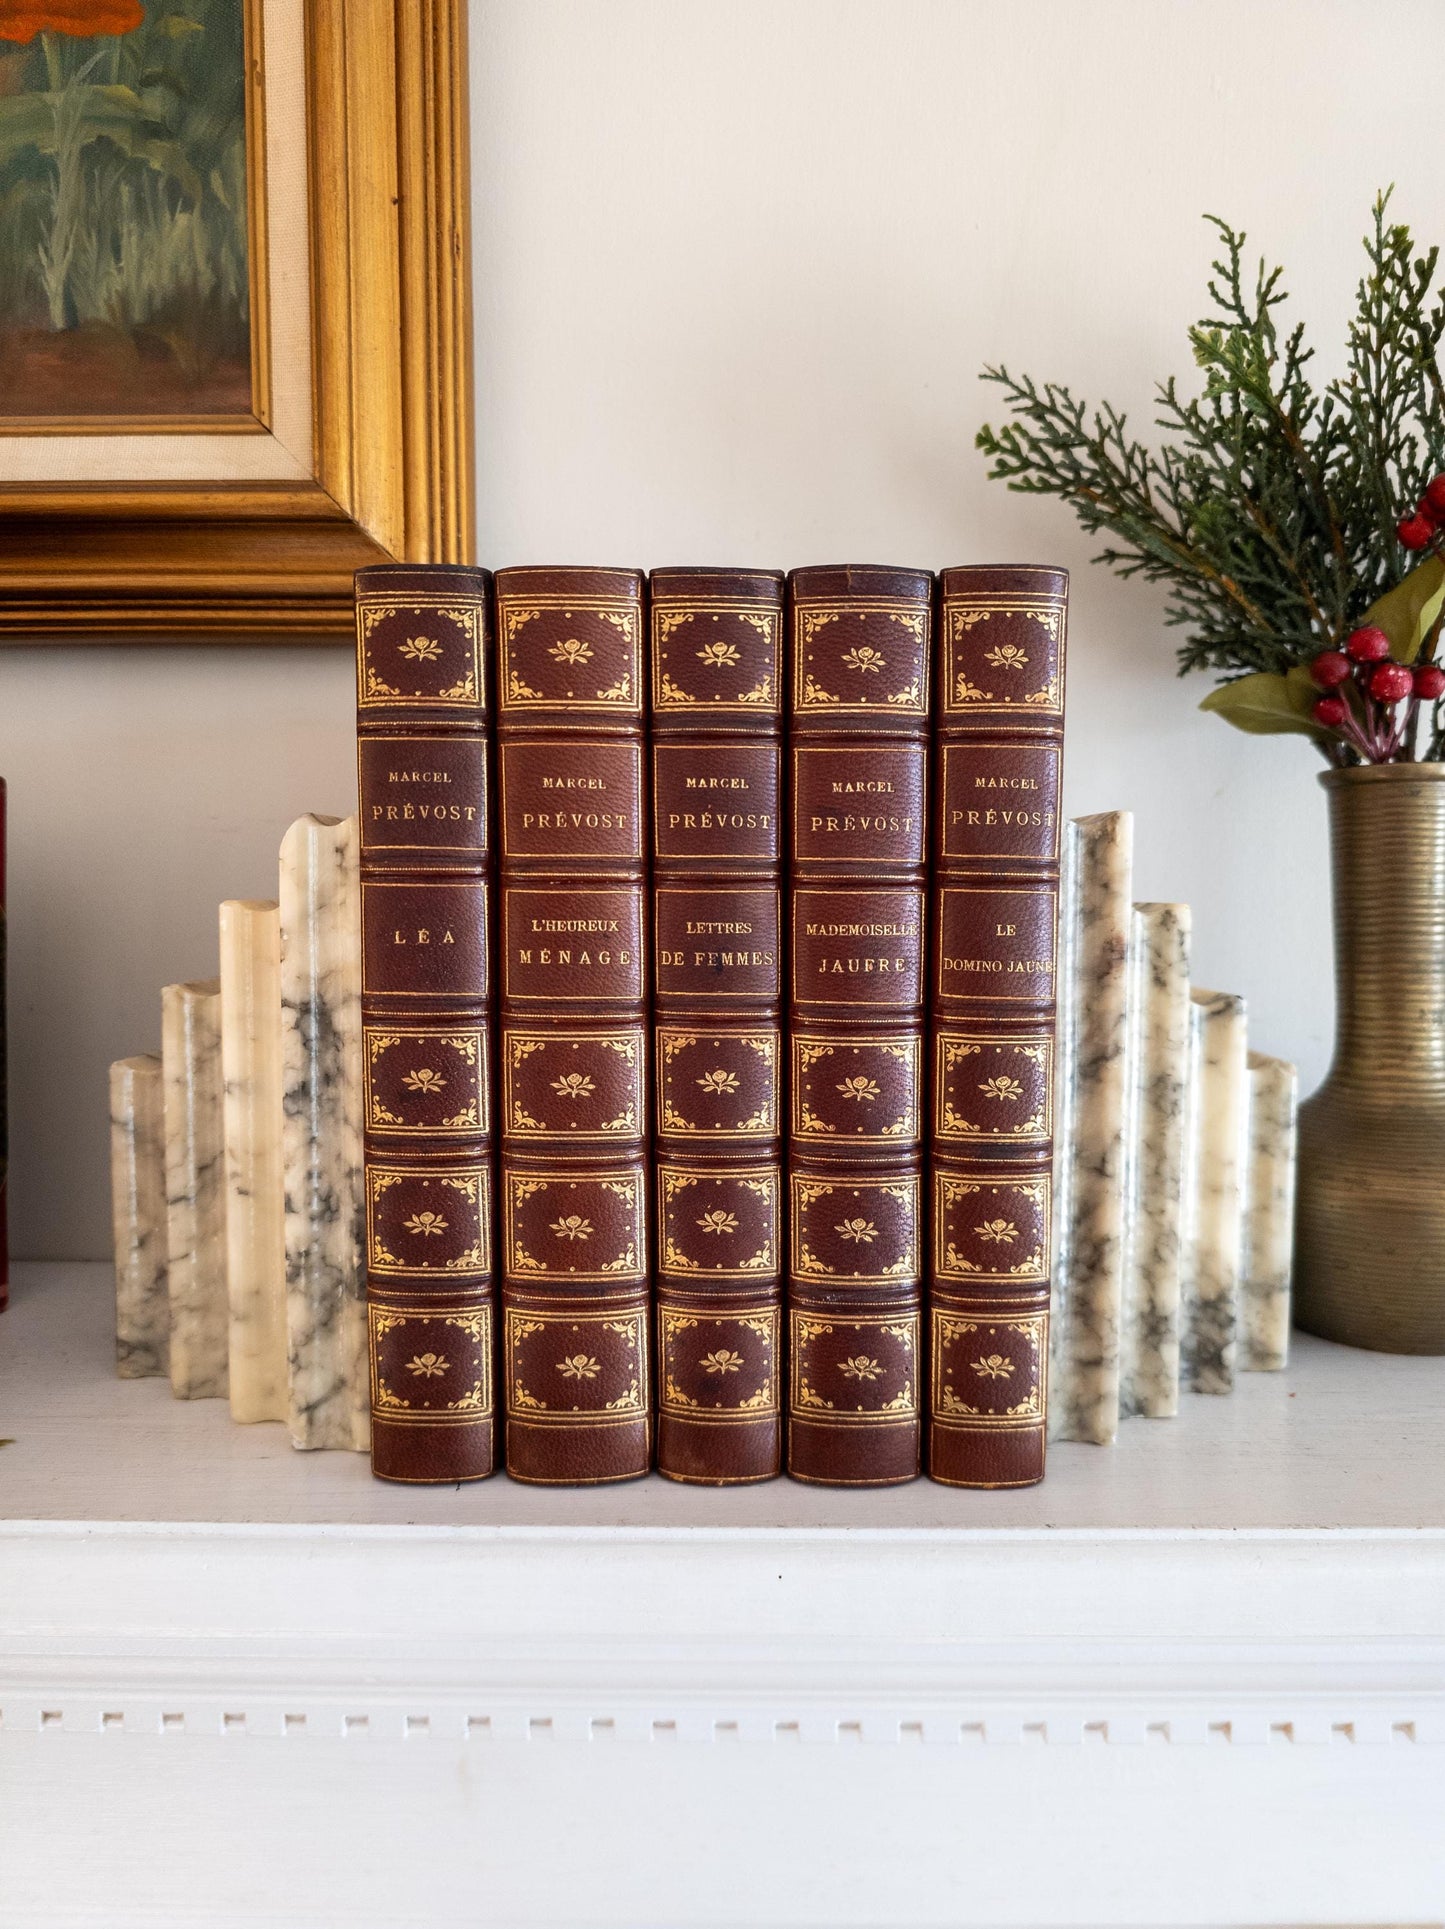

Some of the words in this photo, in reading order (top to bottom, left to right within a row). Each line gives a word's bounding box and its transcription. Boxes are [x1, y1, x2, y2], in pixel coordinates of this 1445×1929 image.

[388, 772, 452, 783] MARCEL
[543, 777, 607, 790] MARCEL
[686, 777, 749, 789] MARCEL
[974, 777, 1039, 790] MARCEL
[832, 781, 895, 793] MARCEL
[372, 803, 477, 821] PRÉVOST
[951, 809, 1054, 827] PRÉVOST
[522, 812, 628, 829] PRÉVOST
[669, 812, 771, 829] PRÉVOST
[811, 815, 914, 833] PRÉVOST
[531, 919, 620, 932] L'HEUREUX
[686, 921, 753, 934] LETTRES
[806, 923, 918, 937] MADEMOISELLE
[996, 924, 1017, 937] LE
[519, 948, 631, 965] MÉNAGE
[661, 951, 685, 966] DE
[694, 951, 774, 966] FEMMES
[818, 958, 906, 973] JAUFRE
[943, 957, 1002, 973] DOMINO
[1007, 959, 1055, 973] JAUNE
